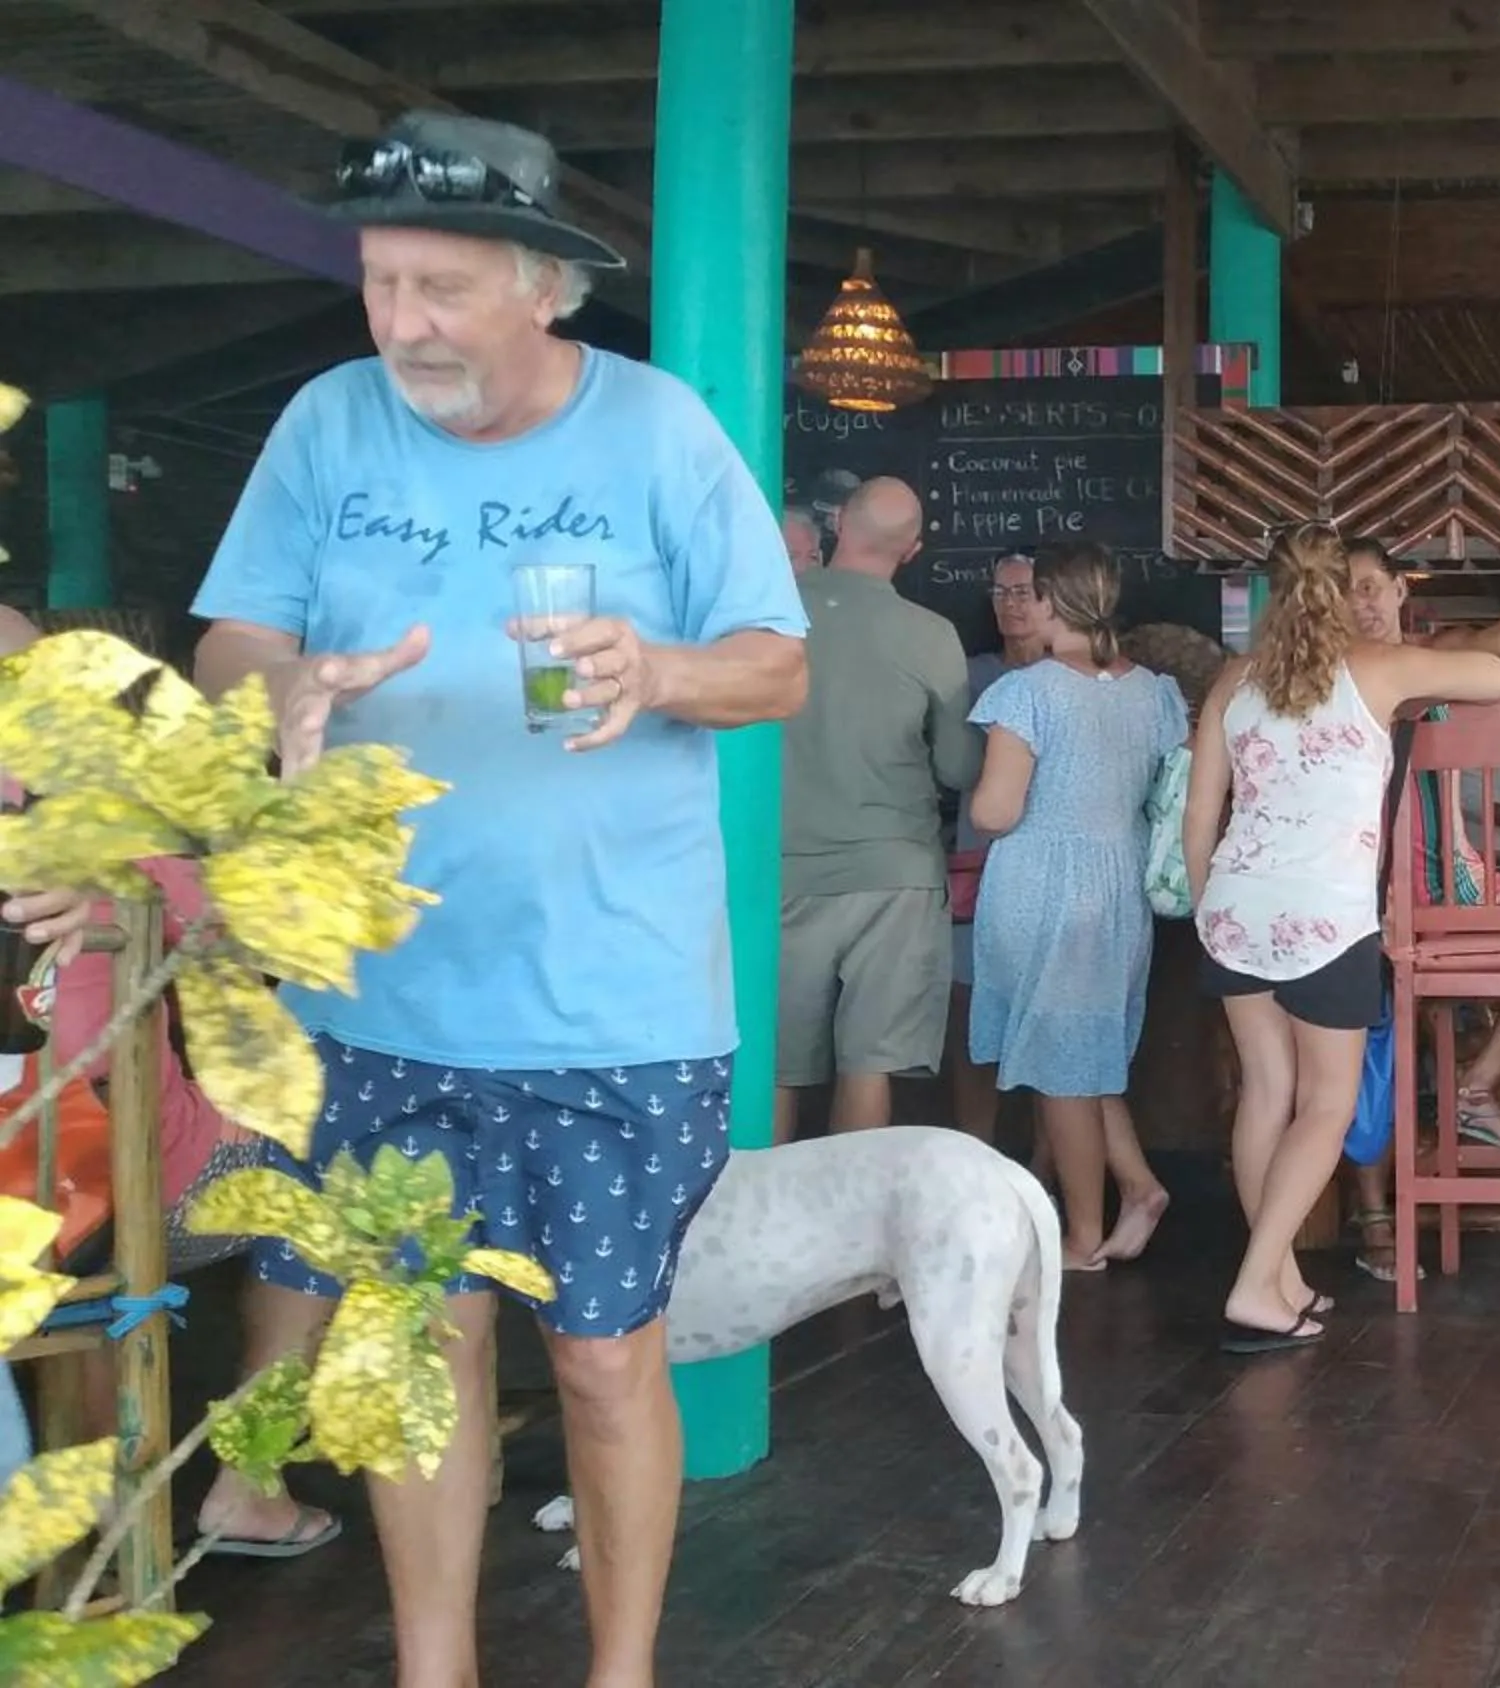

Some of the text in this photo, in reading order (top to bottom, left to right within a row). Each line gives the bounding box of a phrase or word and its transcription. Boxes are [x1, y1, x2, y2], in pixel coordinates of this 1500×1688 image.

[782, 398, 885, 439] rtugal
[941, 401, 1107, 428] DESSERTS
[948, 451, 1089, 481] Coconut pie
[952, 482, 1062, 505] Homemade
[1077, 476, 1117, 502] ICE
[337, 492, 614, 565] Easy Rider
[952, 506, 1085, 537] Apple Pie
